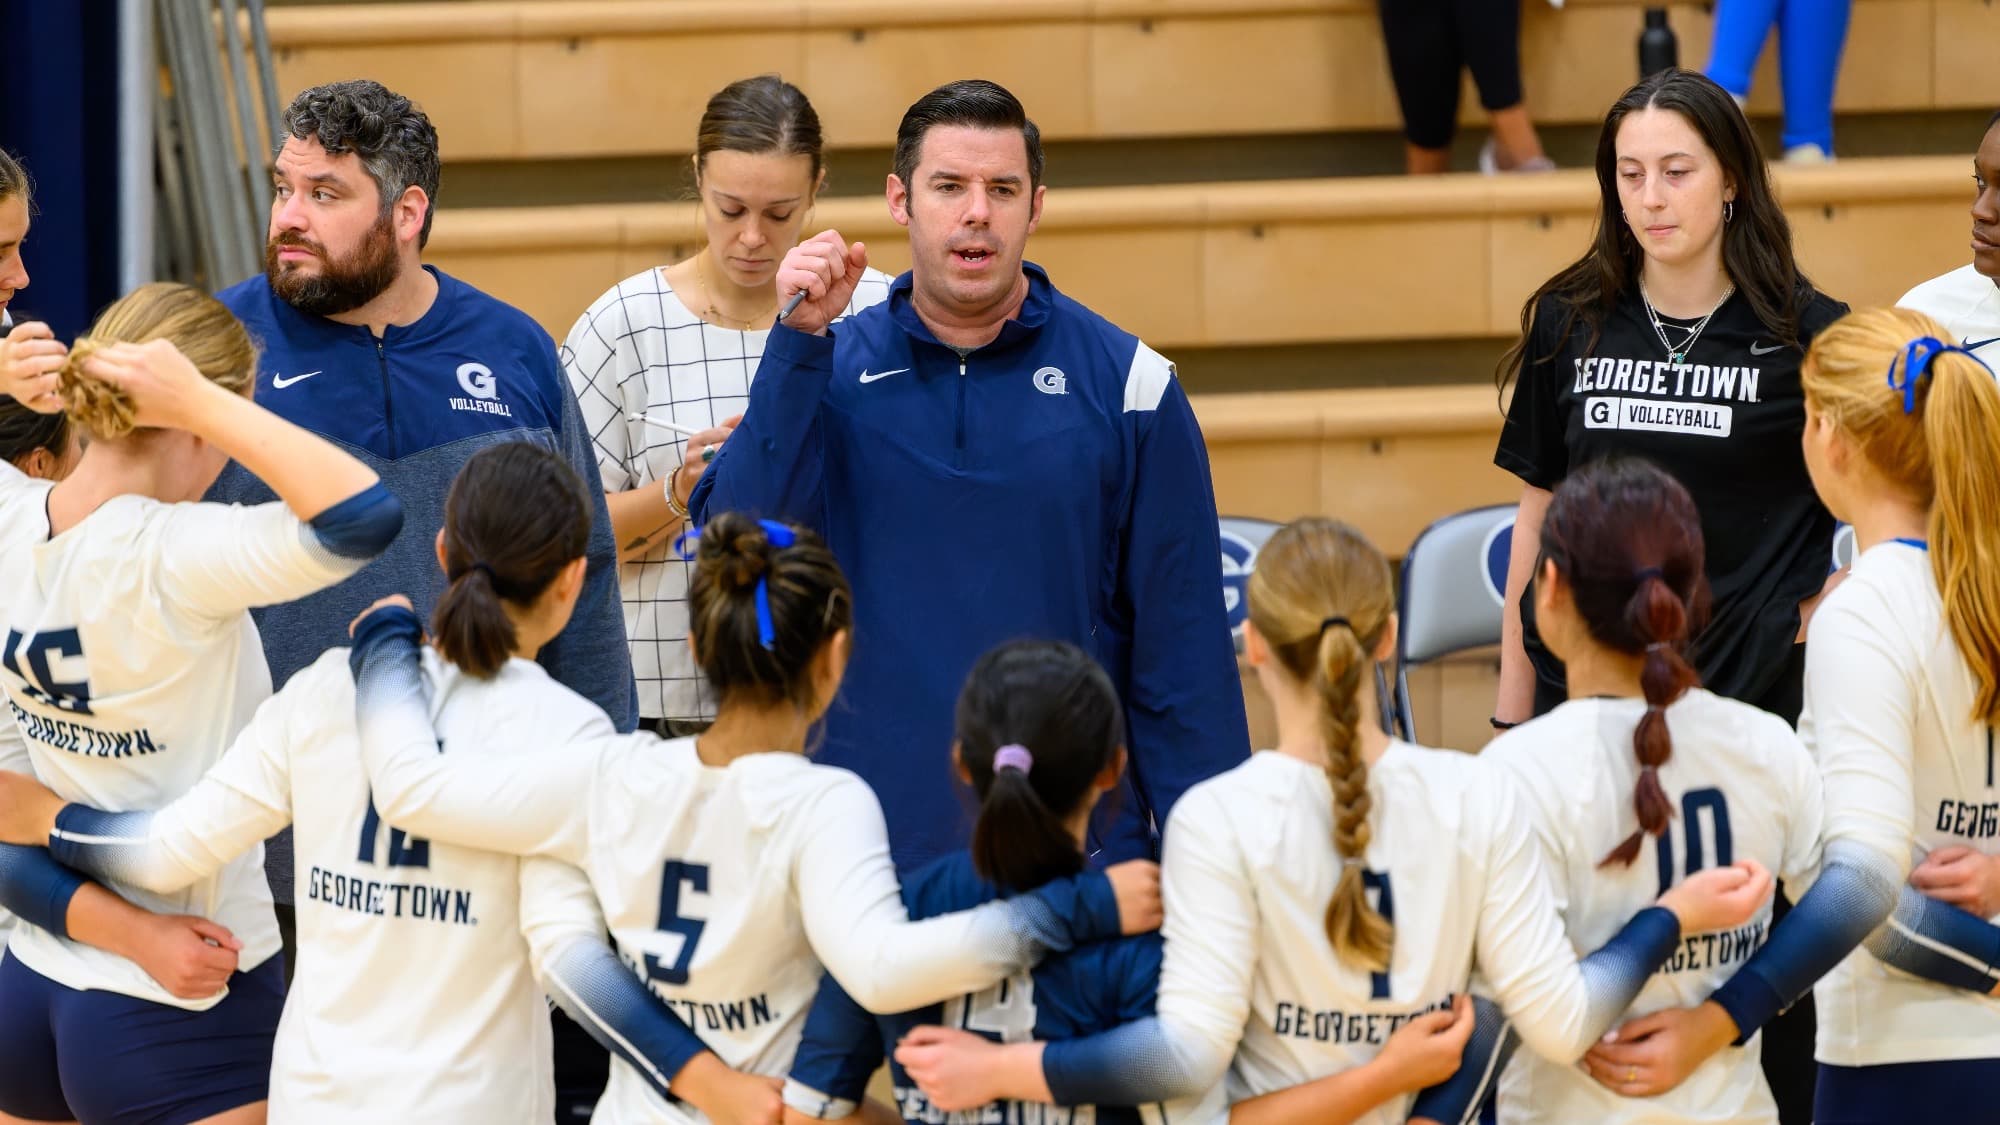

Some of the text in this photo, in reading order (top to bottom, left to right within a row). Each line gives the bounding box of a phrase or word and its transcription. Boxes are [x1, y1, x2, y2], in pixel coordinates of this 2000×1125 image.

[456, 362, 497, 399] G
[1033, 366, 1066, 394] G
[449, 398, 512, 417] VOLLEYBALL
[1591, 401, 1722, 430] G VOLLEYBALL
[1657, 787, 1733, 898] 10
[644, 860, 709, 985] 5
